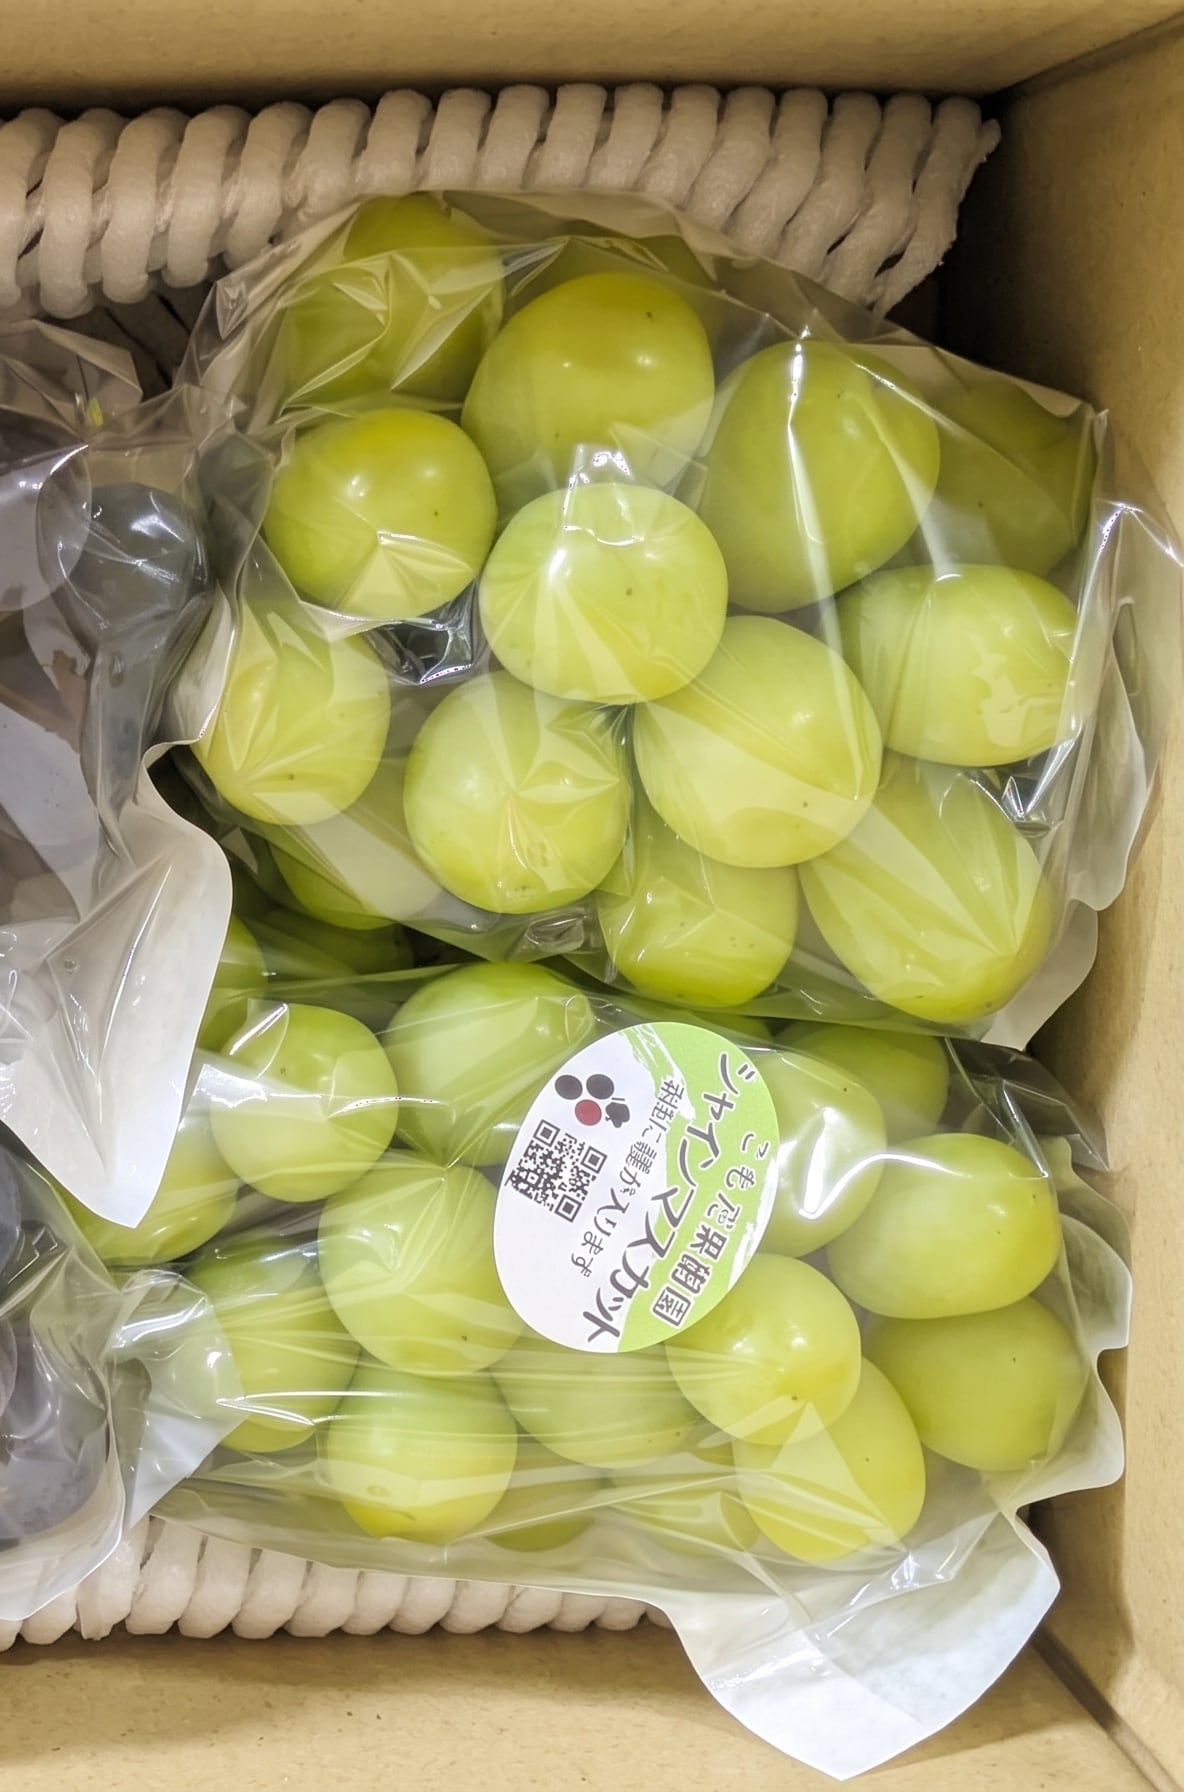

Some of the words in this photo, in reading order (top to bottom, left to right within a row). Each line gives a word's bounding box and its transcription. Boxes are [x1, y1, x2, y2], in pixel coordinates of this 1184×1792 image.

[583, 1053, 756, 1343] シャインマスカット
